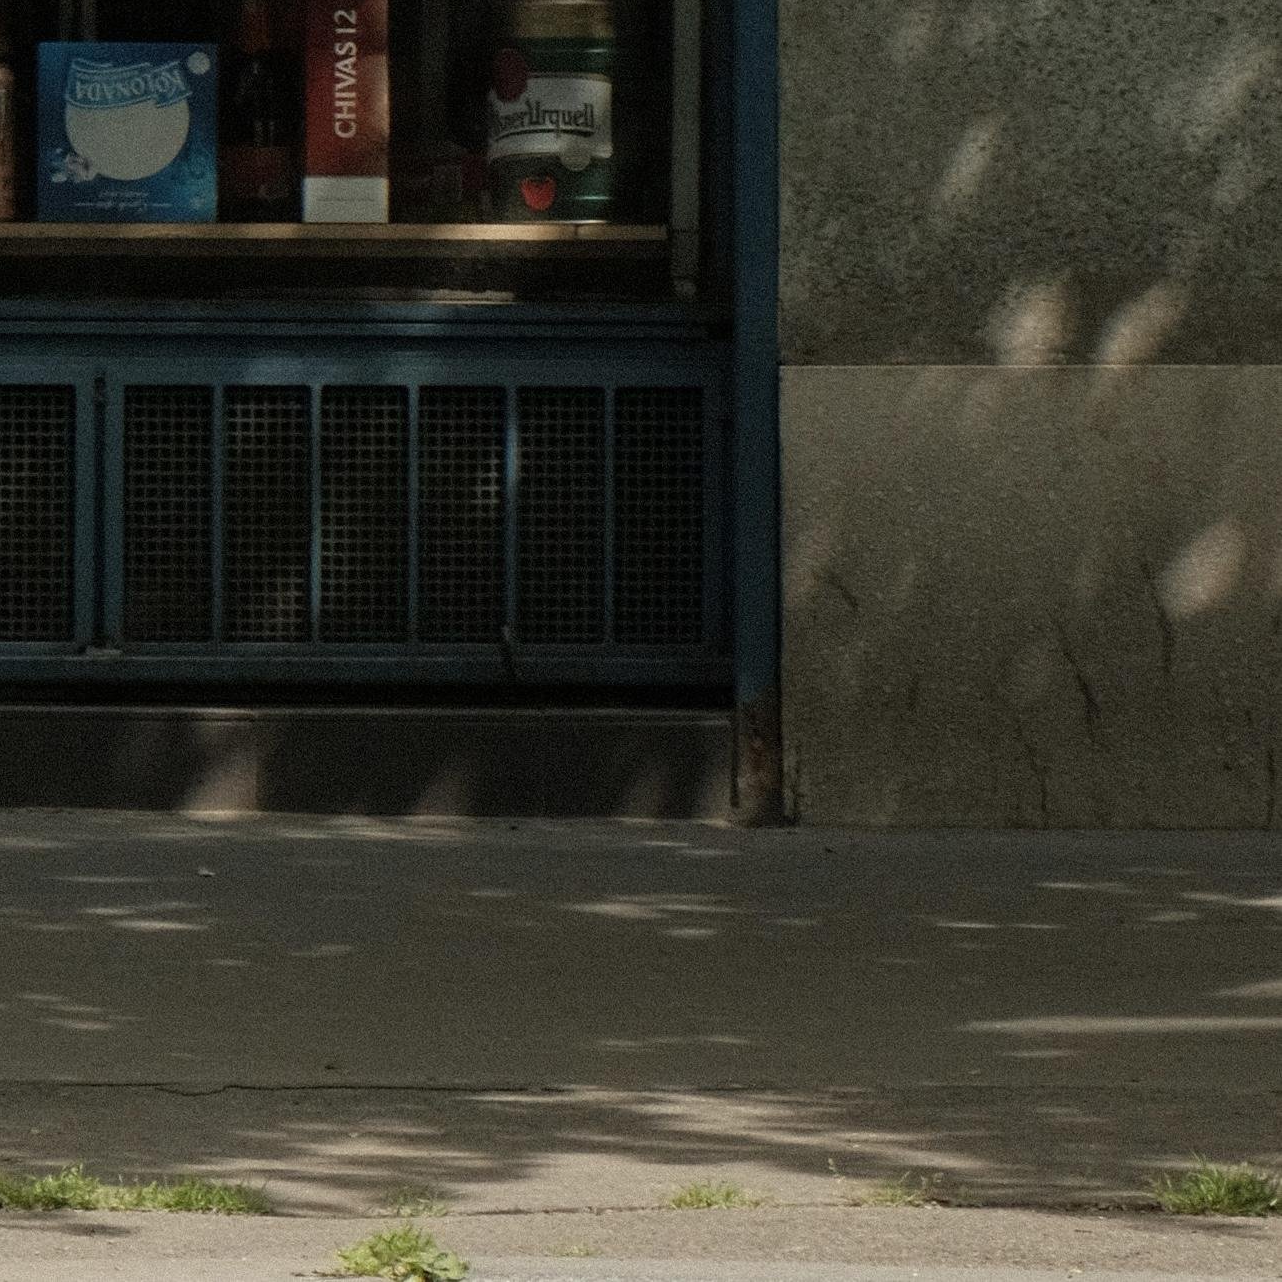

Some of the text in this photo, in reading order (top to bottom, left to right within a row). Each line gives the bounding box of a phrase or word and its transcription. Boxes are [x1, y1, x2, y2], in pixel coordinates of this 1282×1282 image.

[333, 8, 357, 139] CHIVAS 12
[526, 97, 595, 139] Urquell
